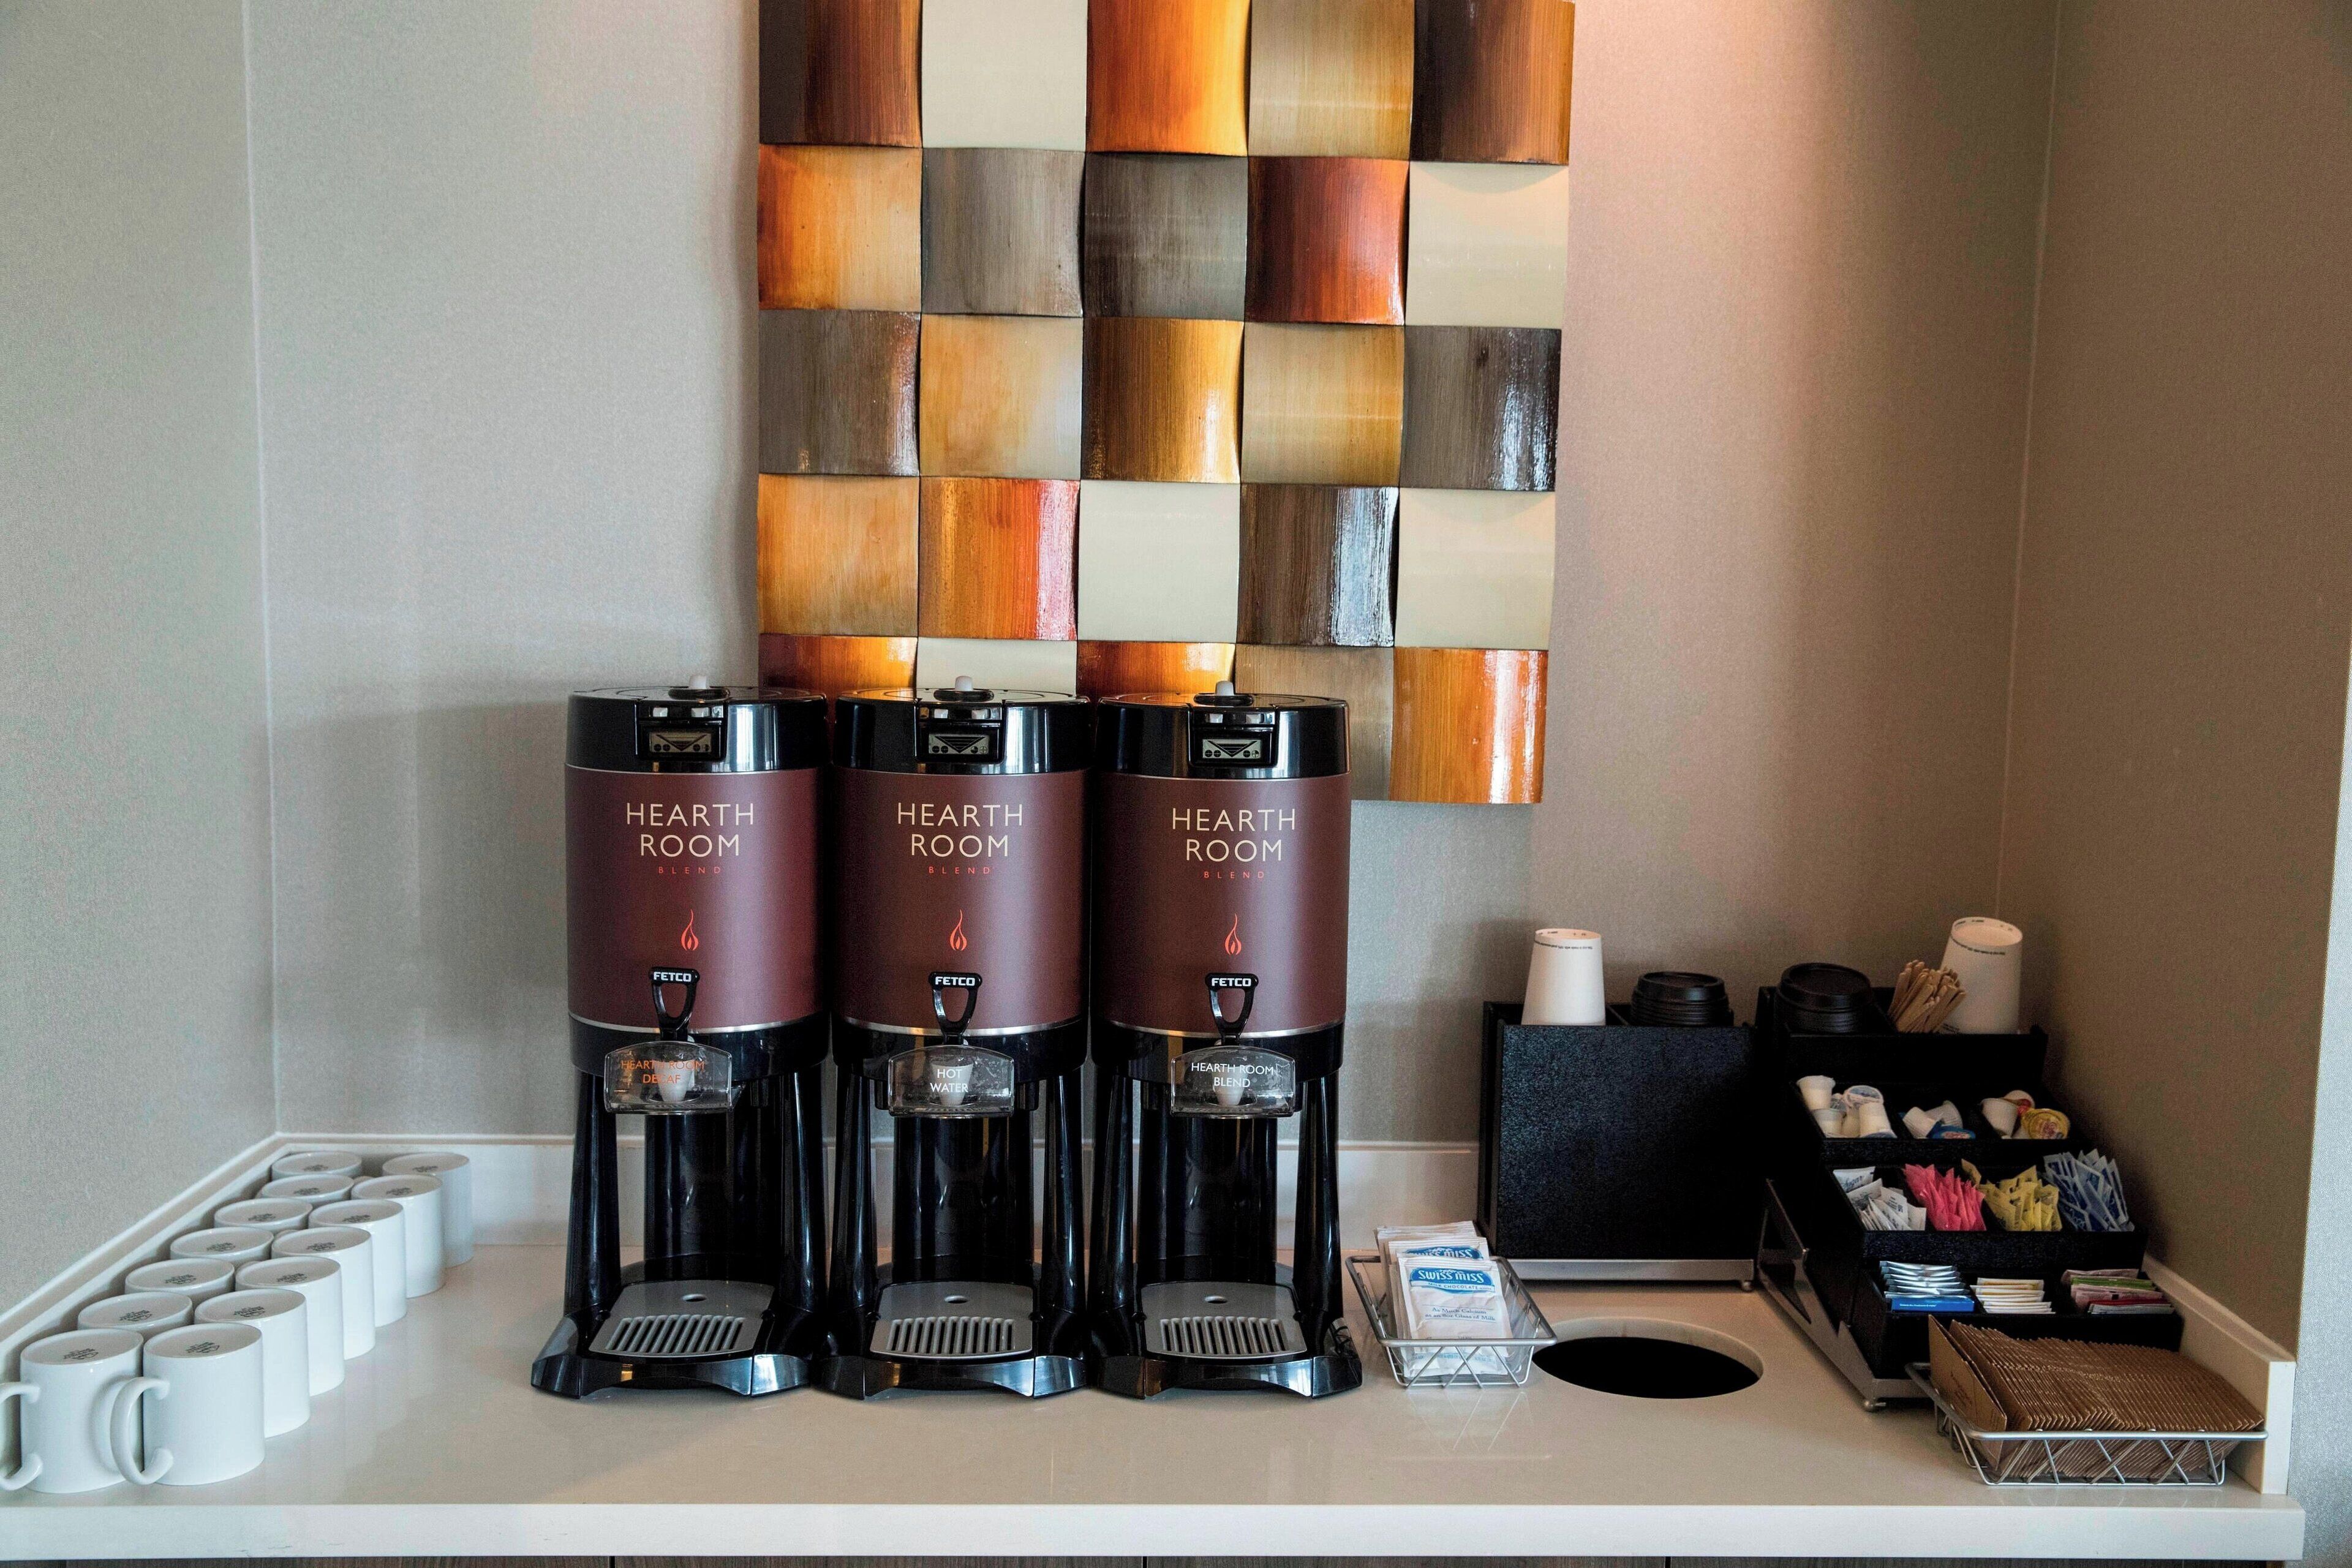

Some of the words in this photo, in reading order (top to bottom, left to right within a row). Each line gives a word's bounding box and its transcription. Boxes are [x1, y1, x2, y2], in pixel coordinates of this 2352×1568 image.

[626, 802, 754, 826] HEARTH
[897, 802, 1023, 827] HEARTH
[1172, 808, 1295, 832] HEARTH
[640, 834, 739, 858] ROOM
[911, 834, 1008, 858] ROOM
[1186, 839, 1282, 862] ROOM
[929, 866, 991, 875] BLEND
[653, 971, 692, 982] FETCO
[935, 976, 975, 987] FETCO
[1211, 978, 1251, 987] FETCO
[620, 1060, 665, 1070] HEARTH
[669, 1060, 705, 1071] ROOM
[1191, 1062, 1235, 1073] HEARTH
[1239, 1065, 1274, 1075] ROOM
[643, 1074, 681, 1084] DECAF
[937, 1068, 963, 1079] HOT
[929, 1082, 969, 1093] WATER
[1213, 1077, 1251, 1088] BLEND
[1418, 1270, 1453, 1280] SWISS
[1455, 1272, 1485, 1284] MISS
